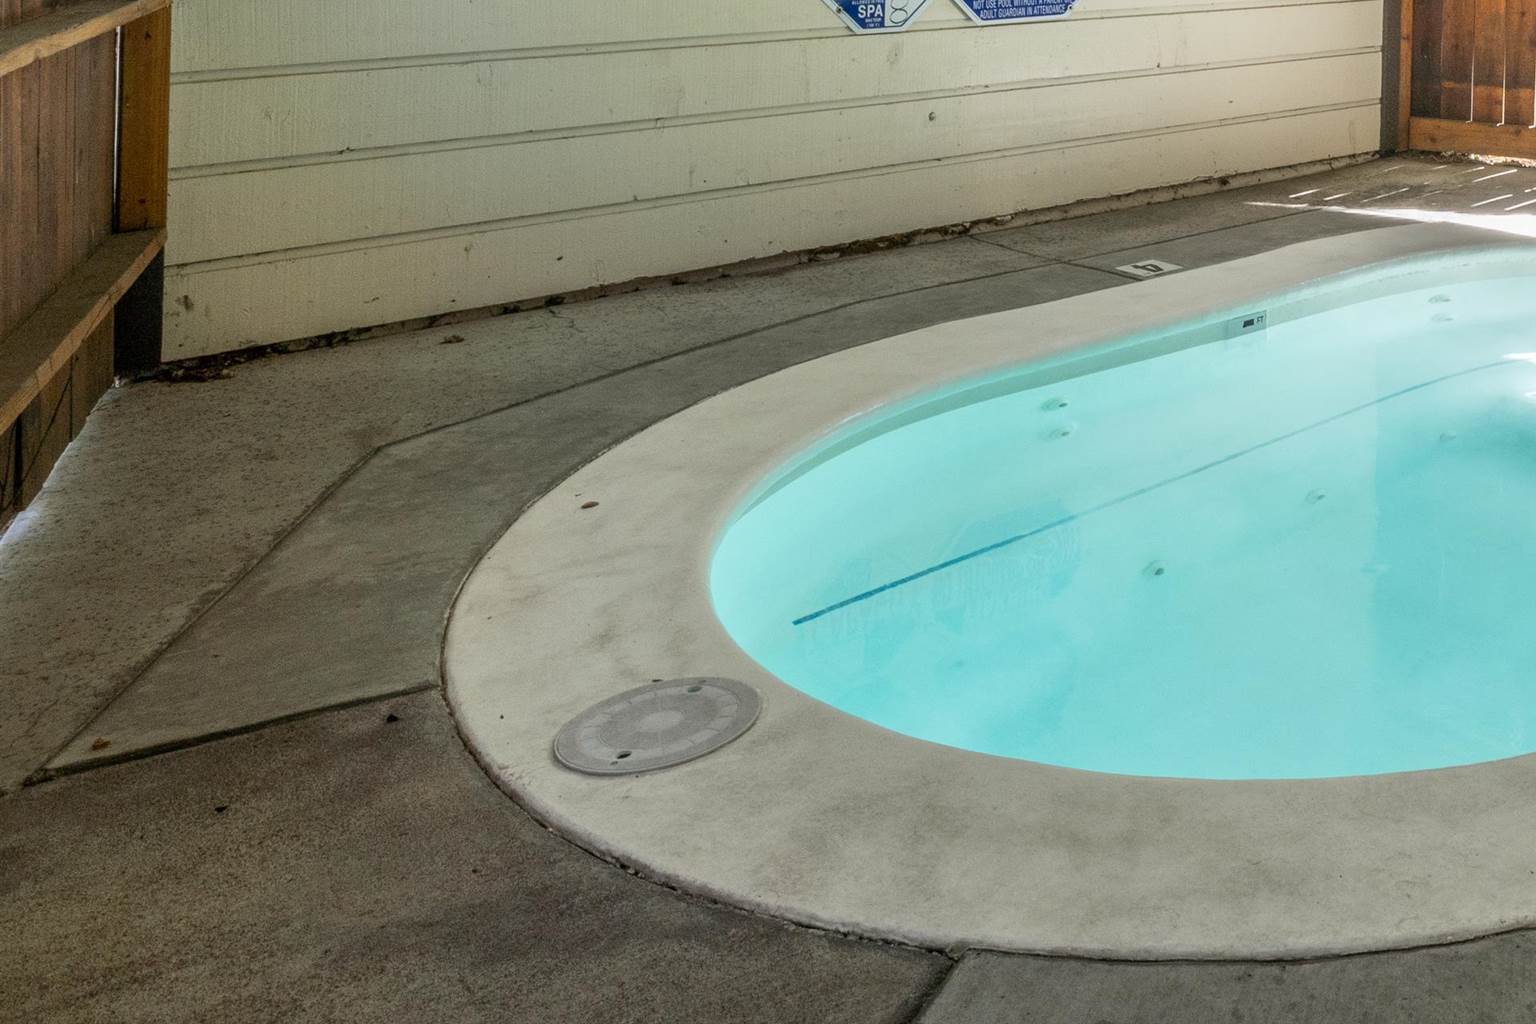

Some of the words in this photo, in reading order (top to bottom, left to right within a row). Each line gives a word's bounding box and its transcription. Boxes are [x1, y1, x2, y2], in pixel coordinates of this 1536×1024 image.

[973, 0, 984, 9] NOT
[986, 0, 996, 8] USE
[858, 5, 883, 18] SPA
[980, 10, 997, 19] ADULT
[998, 8, 1026, 18] GUARDIAN
[1027, 7, 1032, 15] IN
[1033, 6, 1066, 14] ATTENDANCE
[1256, 315, 1264, 324] FT
